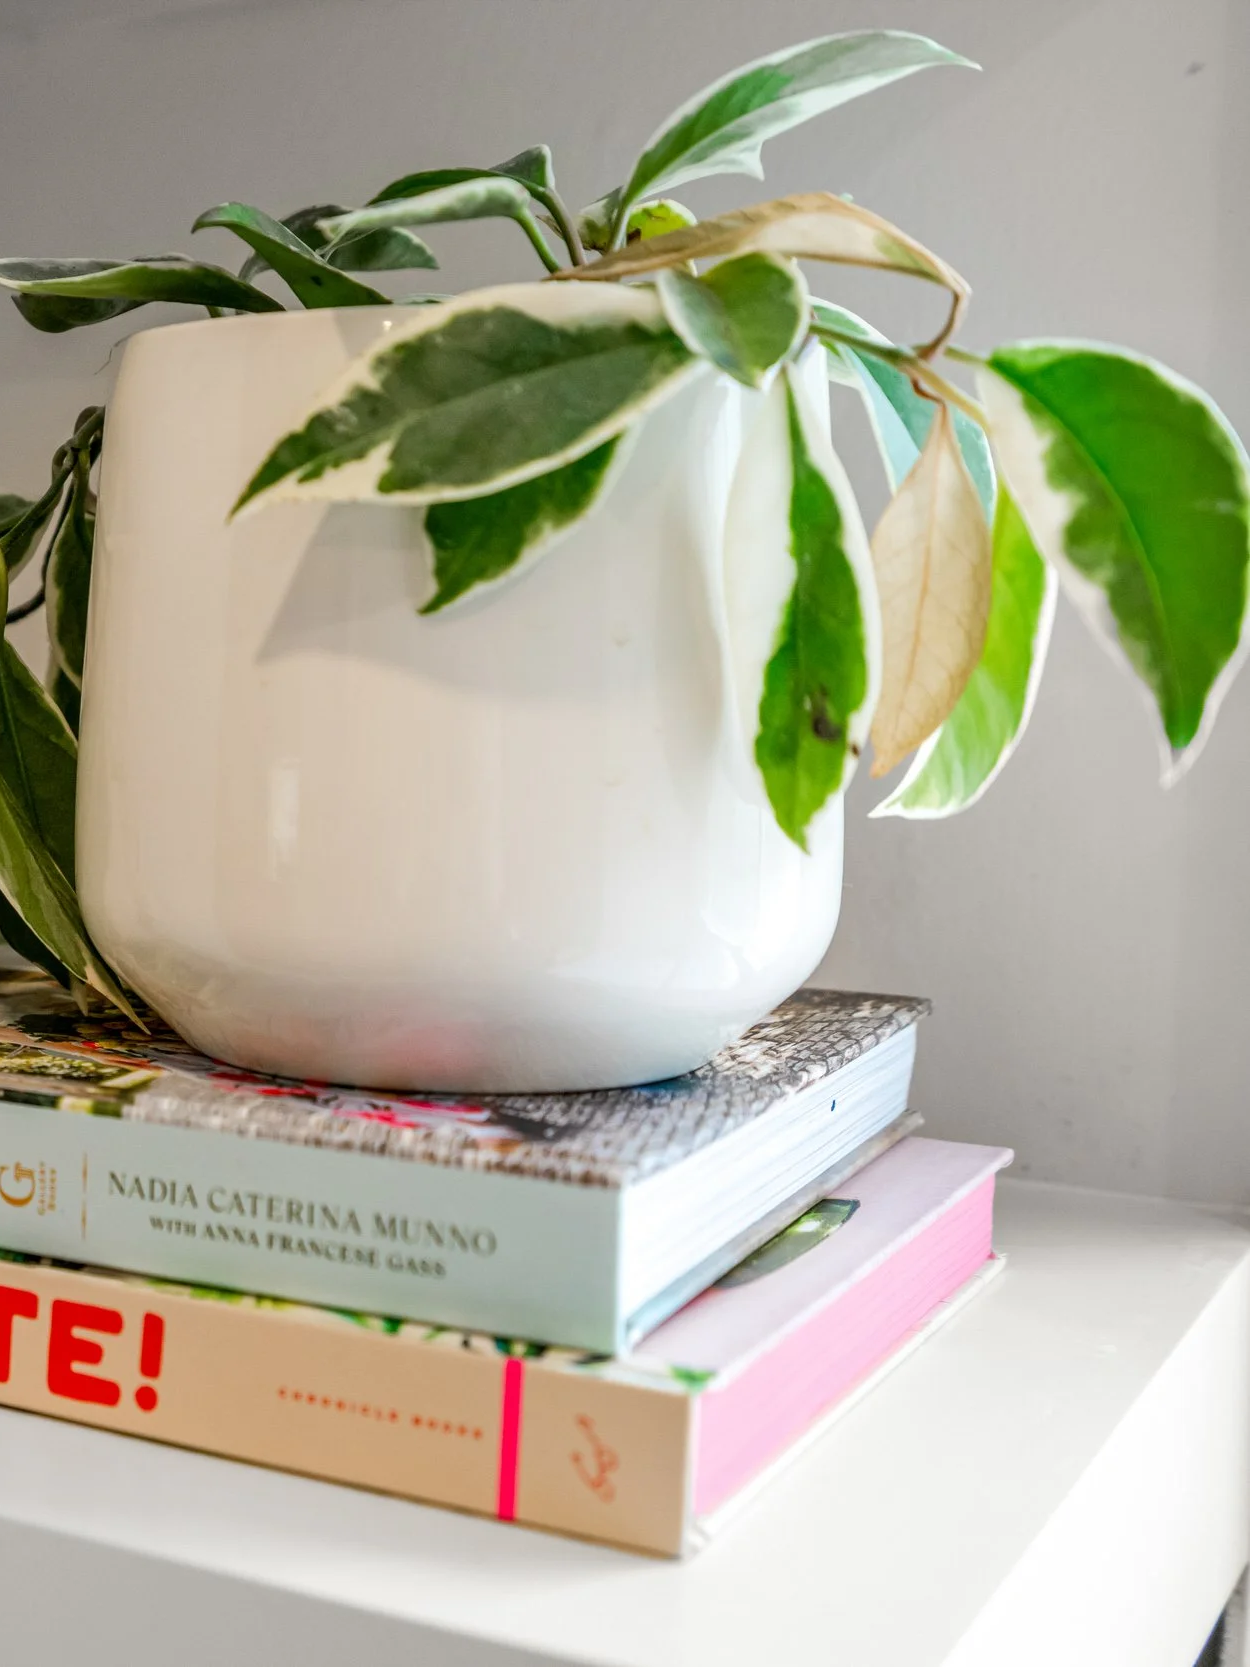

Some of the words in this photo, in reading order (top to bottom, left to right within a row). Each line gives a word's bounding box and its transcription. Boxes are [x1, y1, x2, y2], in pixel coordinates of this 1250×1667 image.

[108, 1170, 199, 1209] NADIA
[206, 1186, 363, 1237] CATERINA
[371, 1211, 498, 1258] MUNNO
[149, 1215, 197, 1238] WITH
[202, 1223, 261, 1249] ANNA
[266, 1232, 381, 1270] FRANCESE
